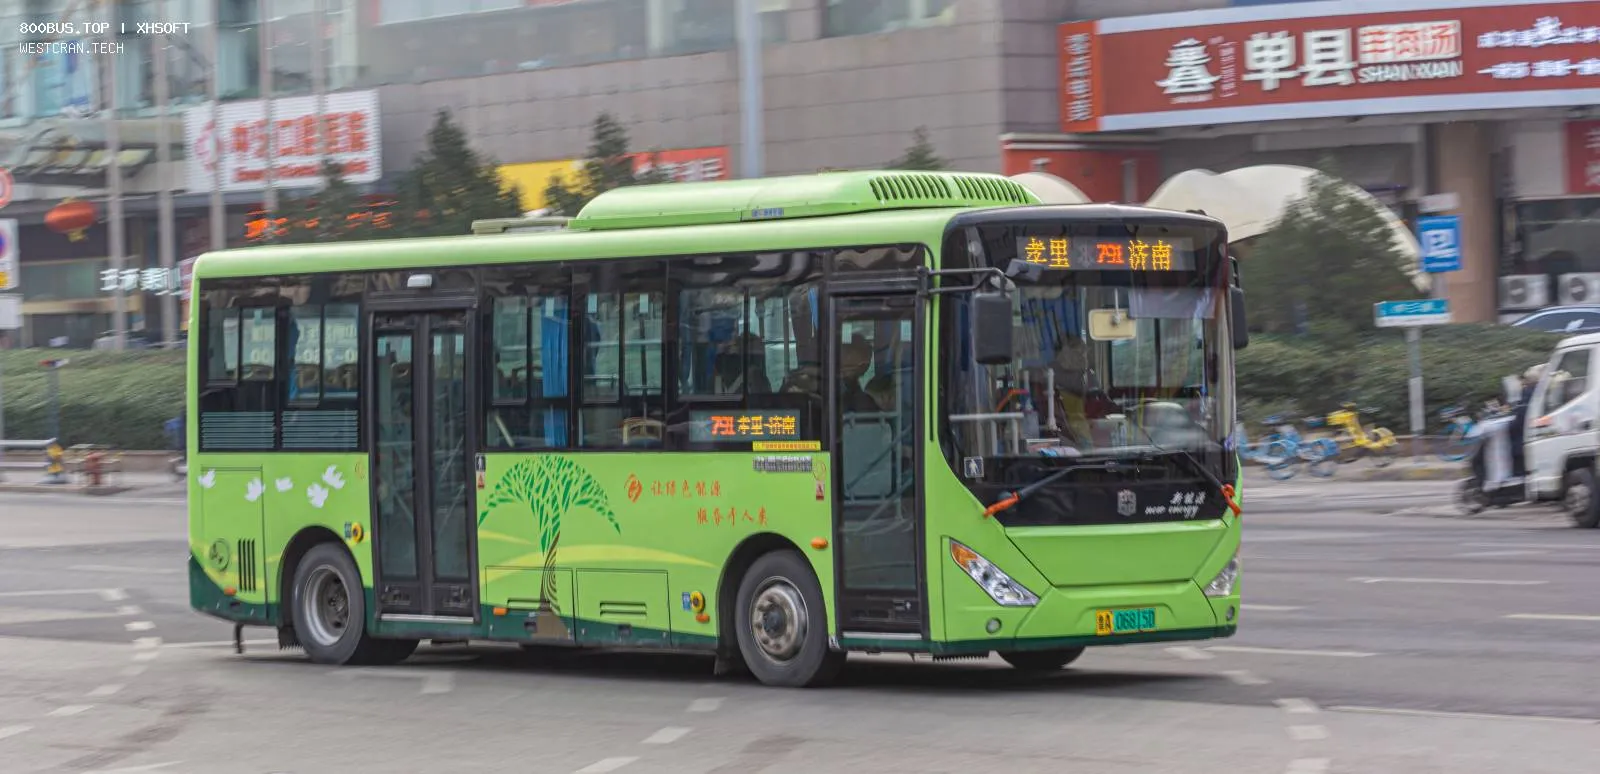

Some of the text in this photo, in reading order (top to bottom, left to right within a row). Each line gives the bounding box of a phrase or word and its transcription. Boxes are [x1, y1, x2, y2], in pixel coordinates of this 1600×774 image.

[1242, 30, 1358, 91] 单县
[1024, 237, 1172, 271] 孝里 791 济南
[711, 415, 736, 435] 791
